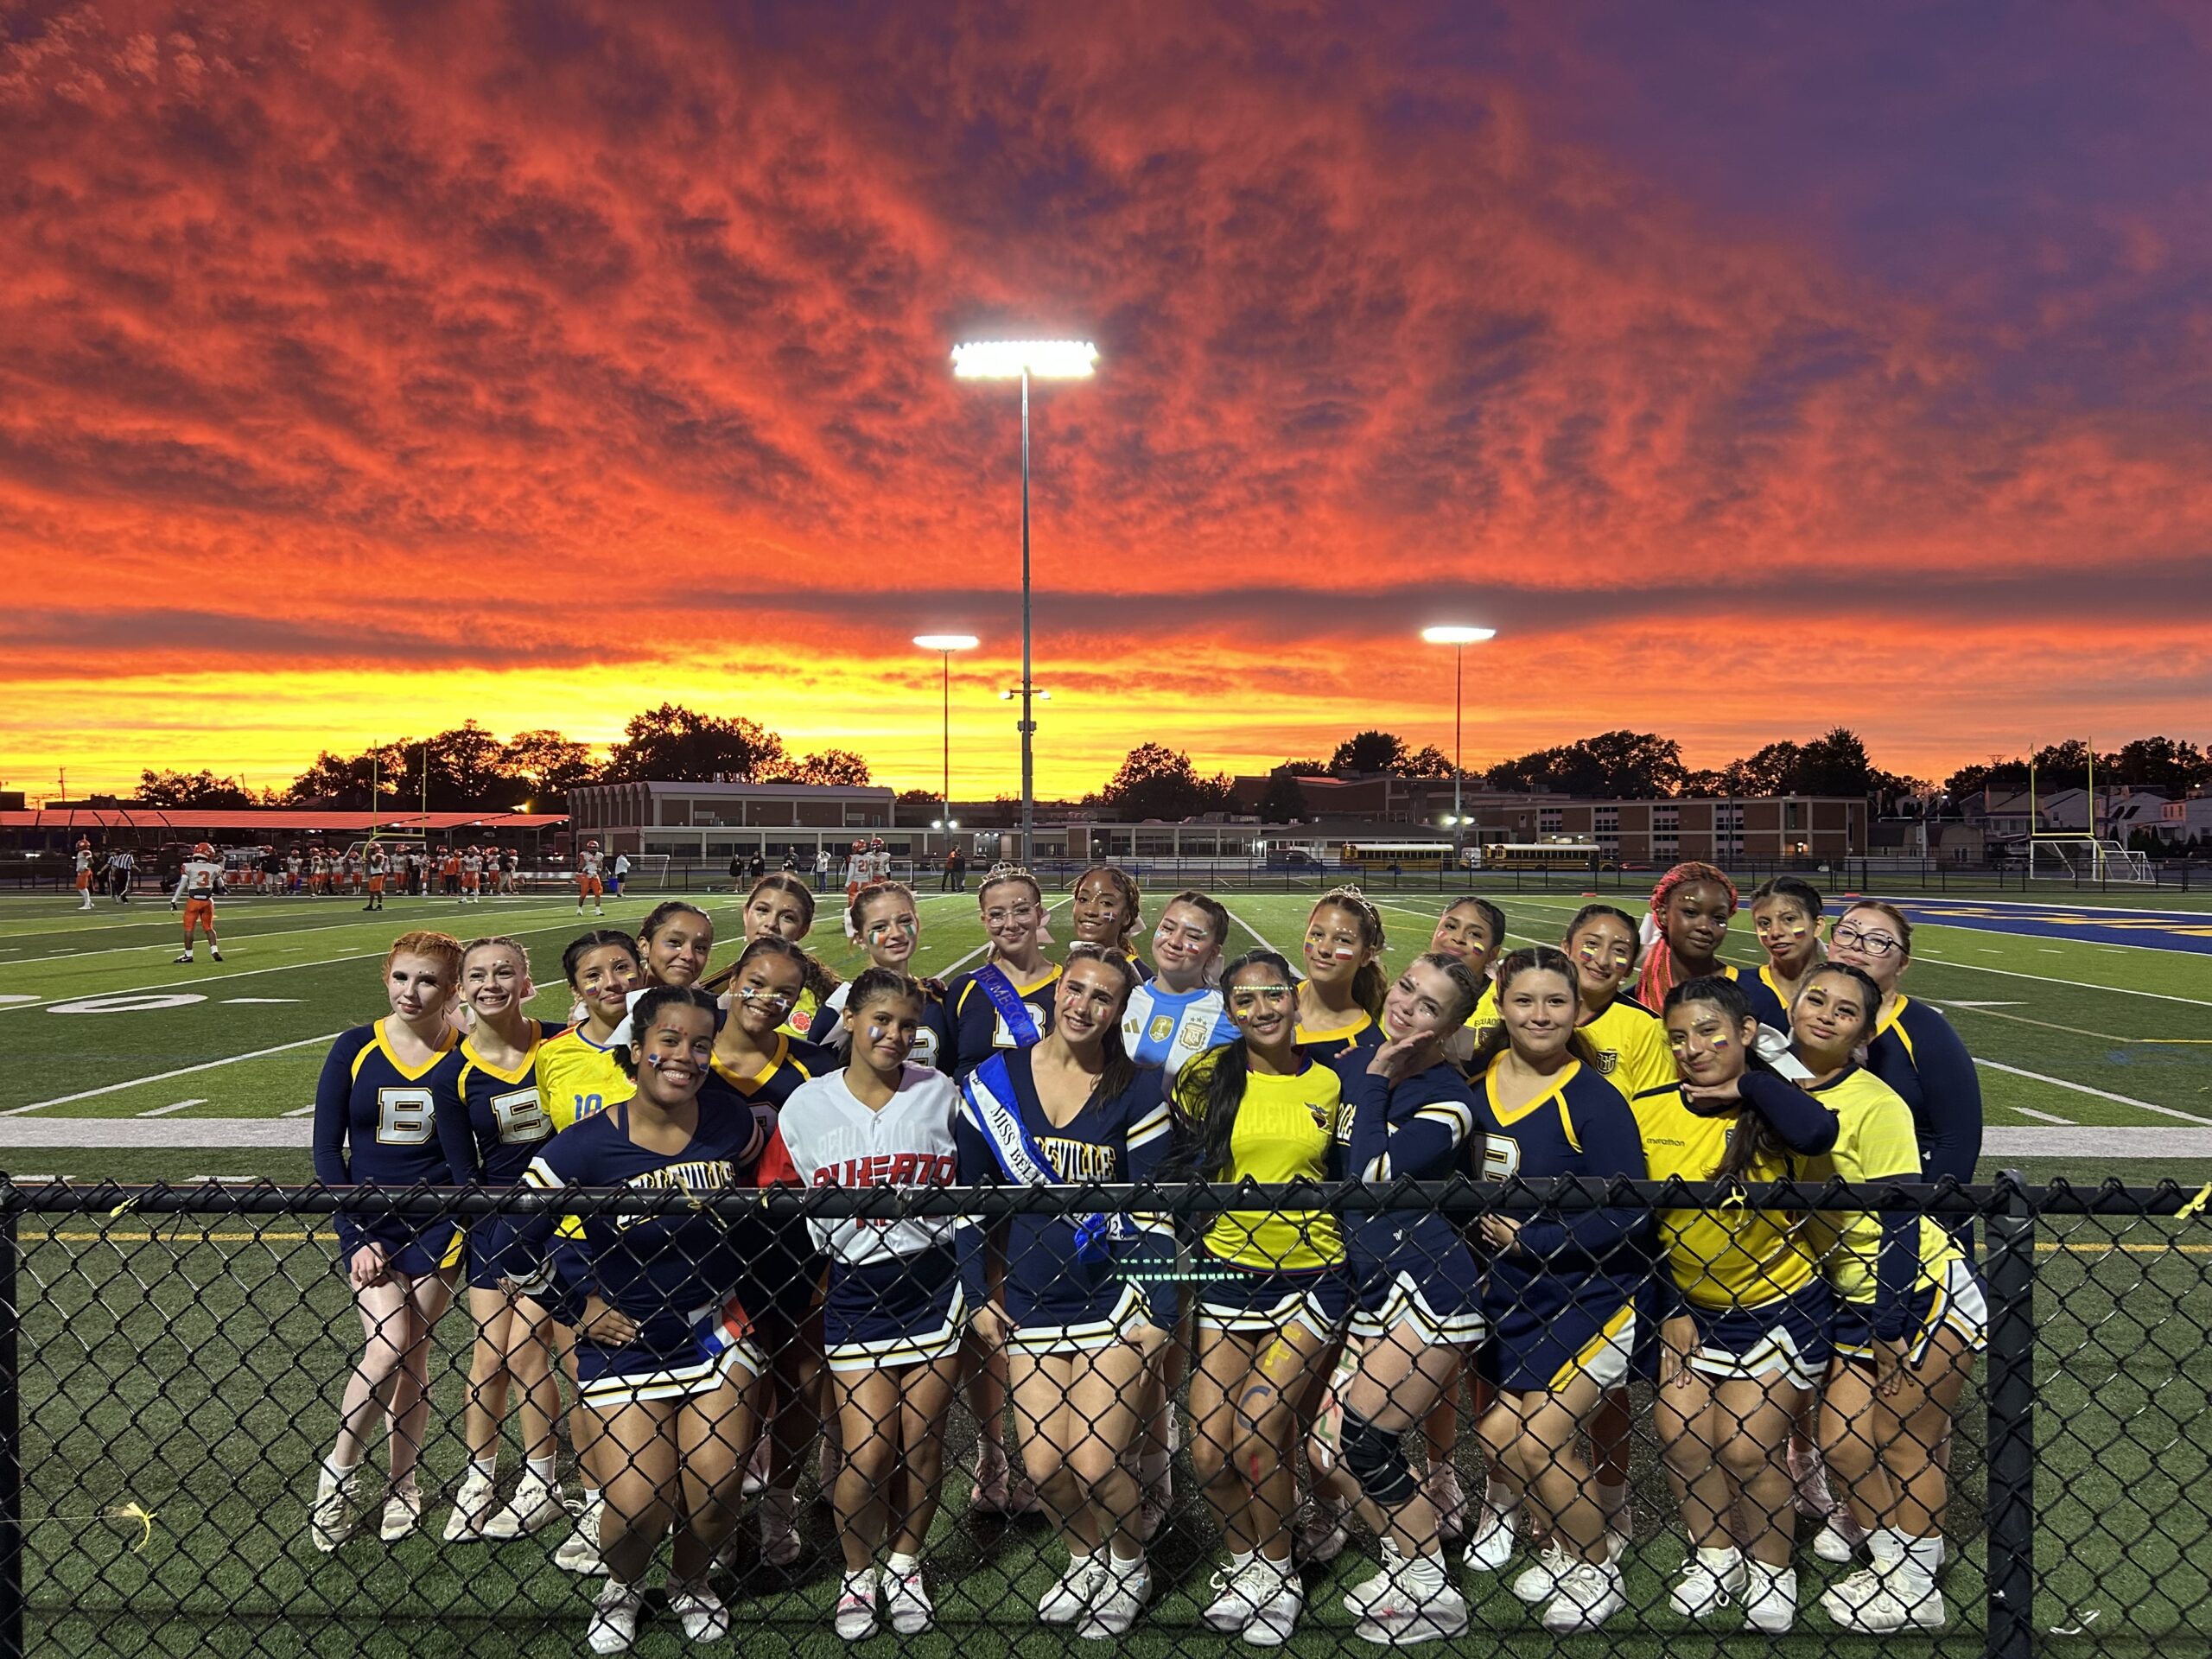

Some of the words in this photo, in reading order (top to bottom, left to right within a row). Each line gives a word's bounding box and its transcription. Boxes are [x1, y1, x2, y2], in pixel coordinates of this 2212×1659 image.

[197, 870, 210, 887] 3
[858, 860, 868, 873] 21
[1474, 1017, 1501, 1027] ECUAD
[376, 1087, 435, 1145] B
[490, 1086, 555, 1145] B
[574, 1093, 602, 1122] 10
[991, 1104, 1015, 1146] MISS
[1009, 1148, 1039, 1183] BELL
[1033, 1135, 1117, 1185] EVILLE
